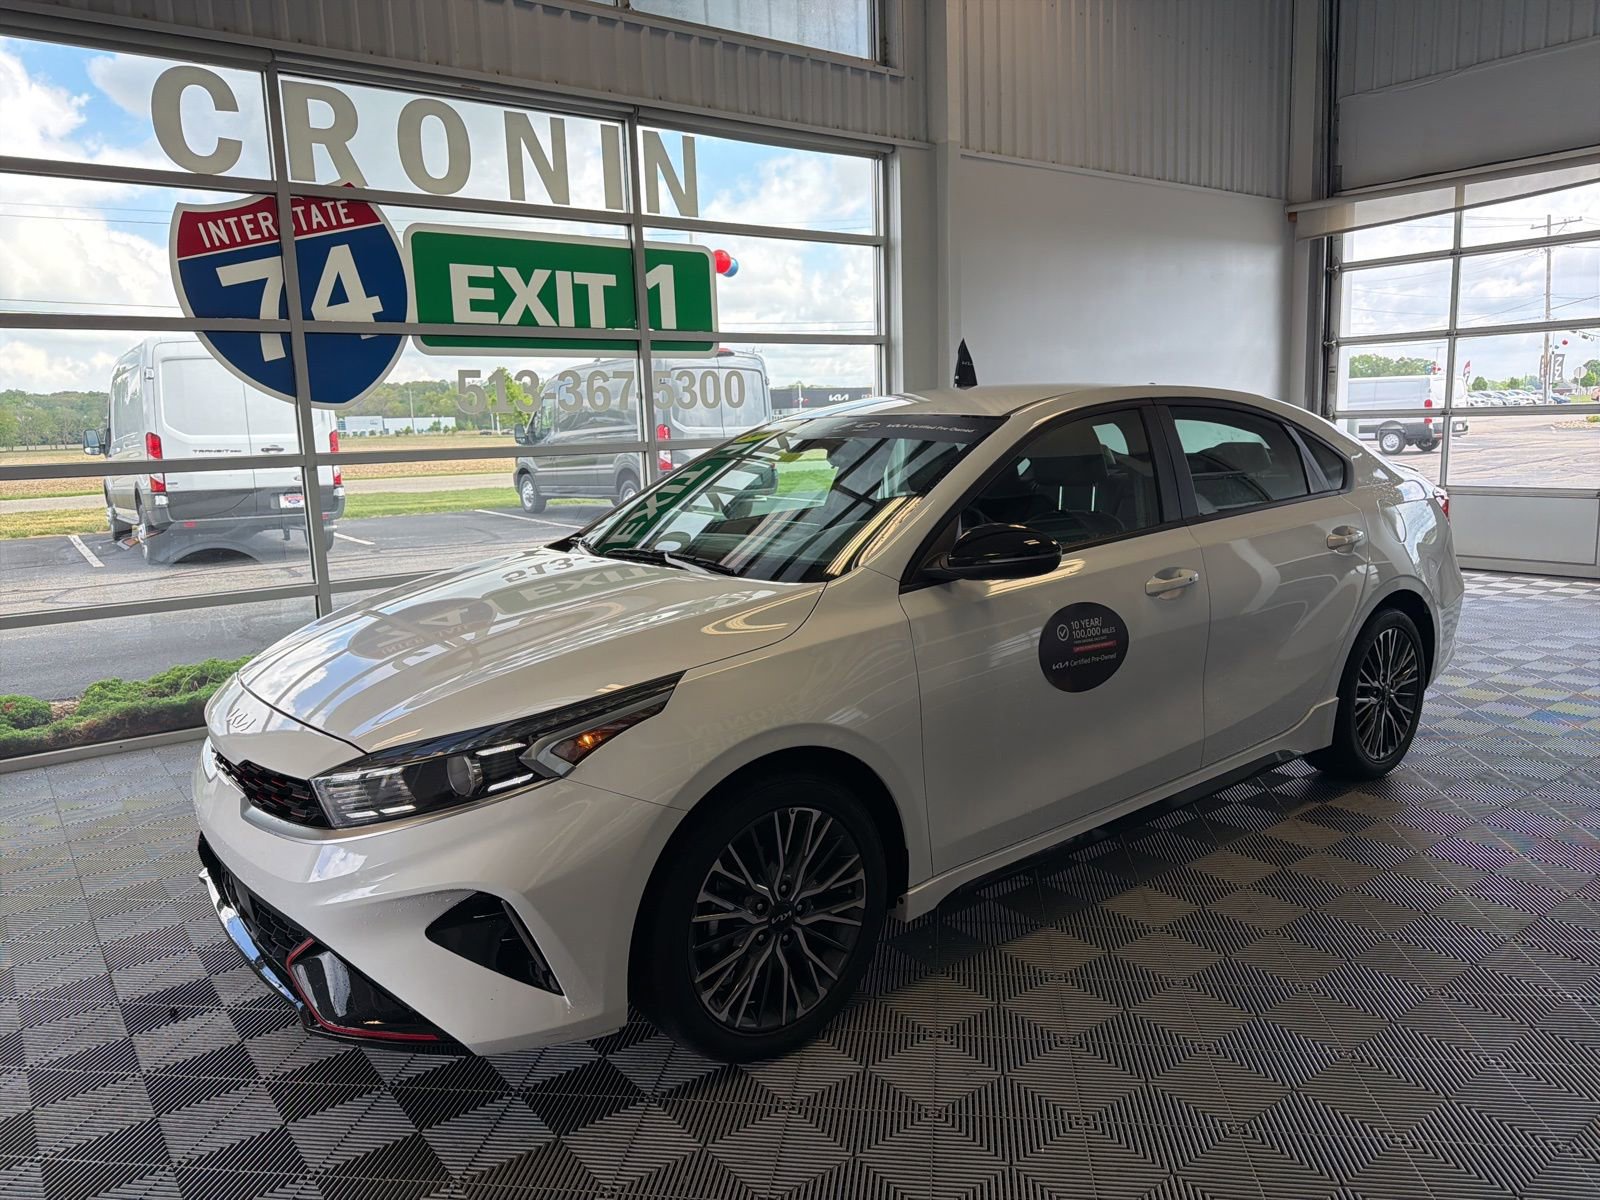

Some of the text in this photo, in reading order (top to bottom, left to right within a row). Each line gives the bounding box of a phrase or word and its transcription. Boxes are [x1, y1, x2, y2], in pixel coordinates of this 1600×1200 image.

[150, 65, 699, 218] CRONIN
[197, 200, 355, 249] INTERTATE
[216, 244, 384, 362] 74
[449, 263, 677, 330] EXIT 1
[457, 369, 746, 415] 513-3675300
[1071, 617, 1102, 630] 10 YEAR/
[1072, 626, 1116, 639] 100,000 MILES
[1070, 657, 1091, 667] Certified
